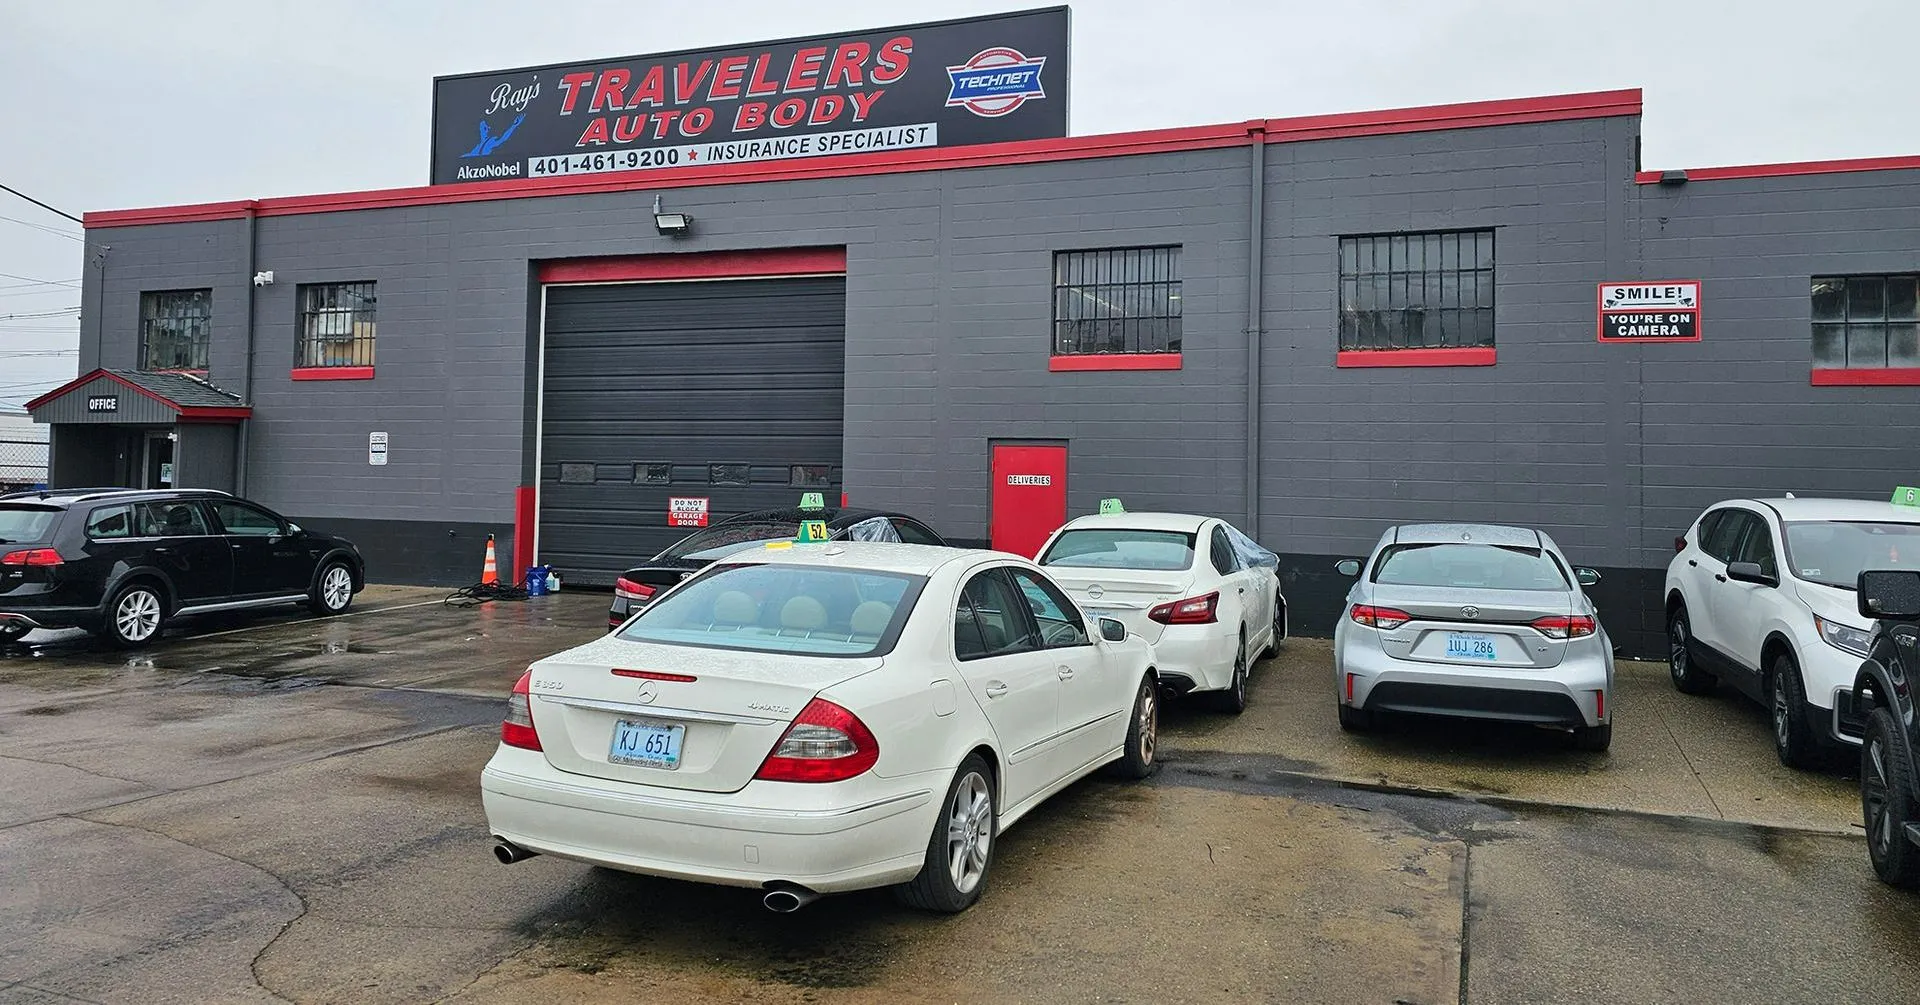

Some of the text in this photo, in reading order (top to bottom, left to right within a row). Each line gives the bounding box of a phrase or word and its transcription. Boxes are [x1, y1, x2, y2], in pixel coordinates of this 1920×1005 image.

[558, 36, 914, 116] TRAVELERS
[485, 75, 541, 115] Ray's
[575, 89, 886, 147] AUTO BODY
[535, 127, 929, 175] 401-461-9200 INSURANCE SPECIALIST
[457, 161, 520, 179] AkzoNobel
[1614, 287, 1682, 299] SMILE!
[1608, 314, 1690, 324] YOU'RE ON
[1618, 325, 1680, 336] CAMERA
[89, 398, 117, 410] OFFICE
[1008, 476, 1050, 484] DELIVERIES
[811, 524, 823, 539] 52
[1449, 640, 1493, 653] 1UJ 286
[619, 730, 671, 755] KJ 651
